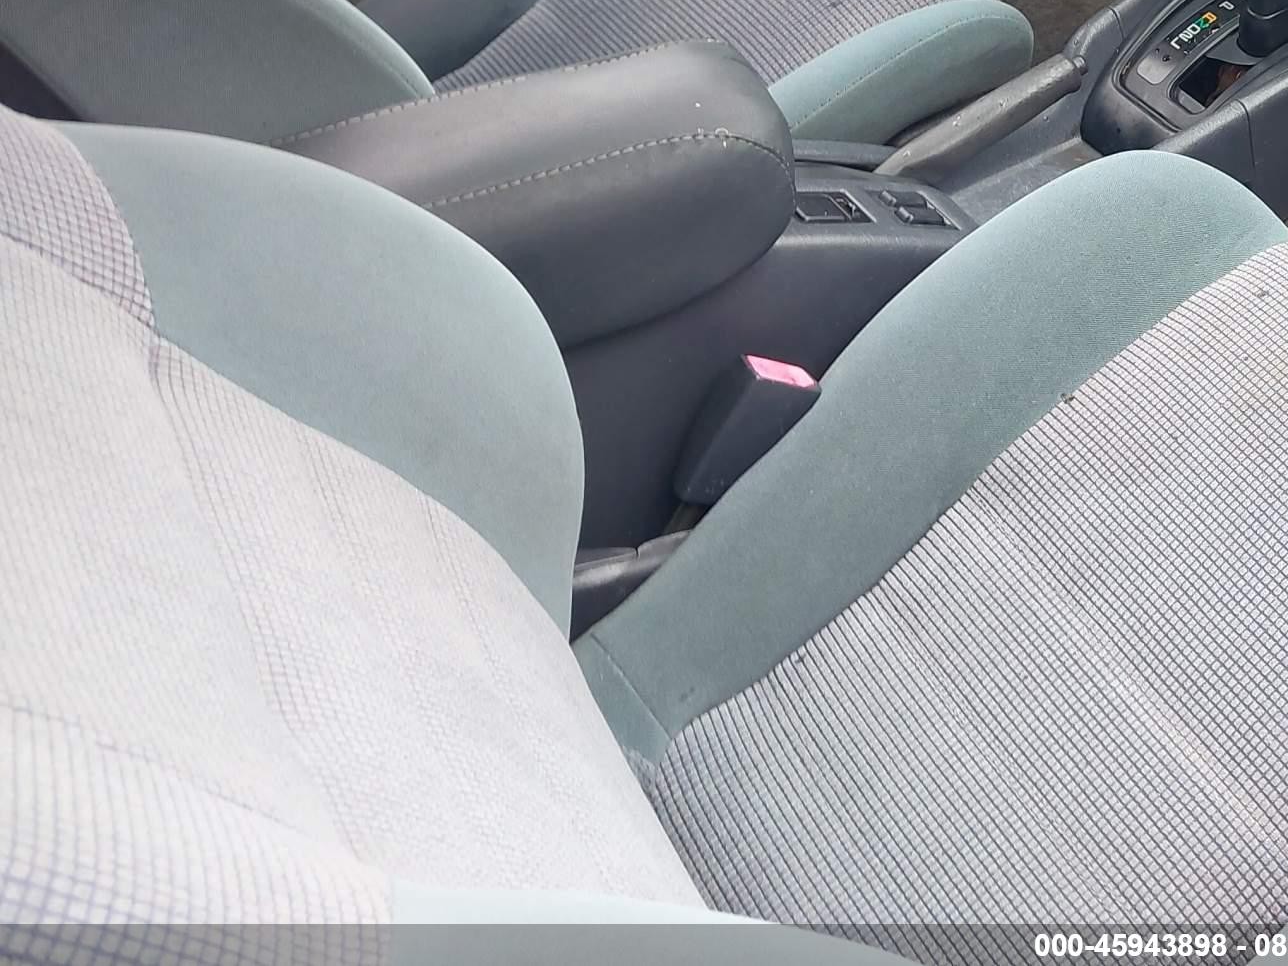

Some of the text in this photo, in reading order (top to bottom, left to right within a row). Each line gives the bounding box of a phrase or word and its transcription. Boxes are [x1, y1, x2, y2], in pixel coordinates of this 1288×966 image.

[1218, 1, 1235, 11] P
[1186, 23, 1201, 35] D
[1179, 30, 1193, 42] 2
[1170, 36, 1181, 50] L
